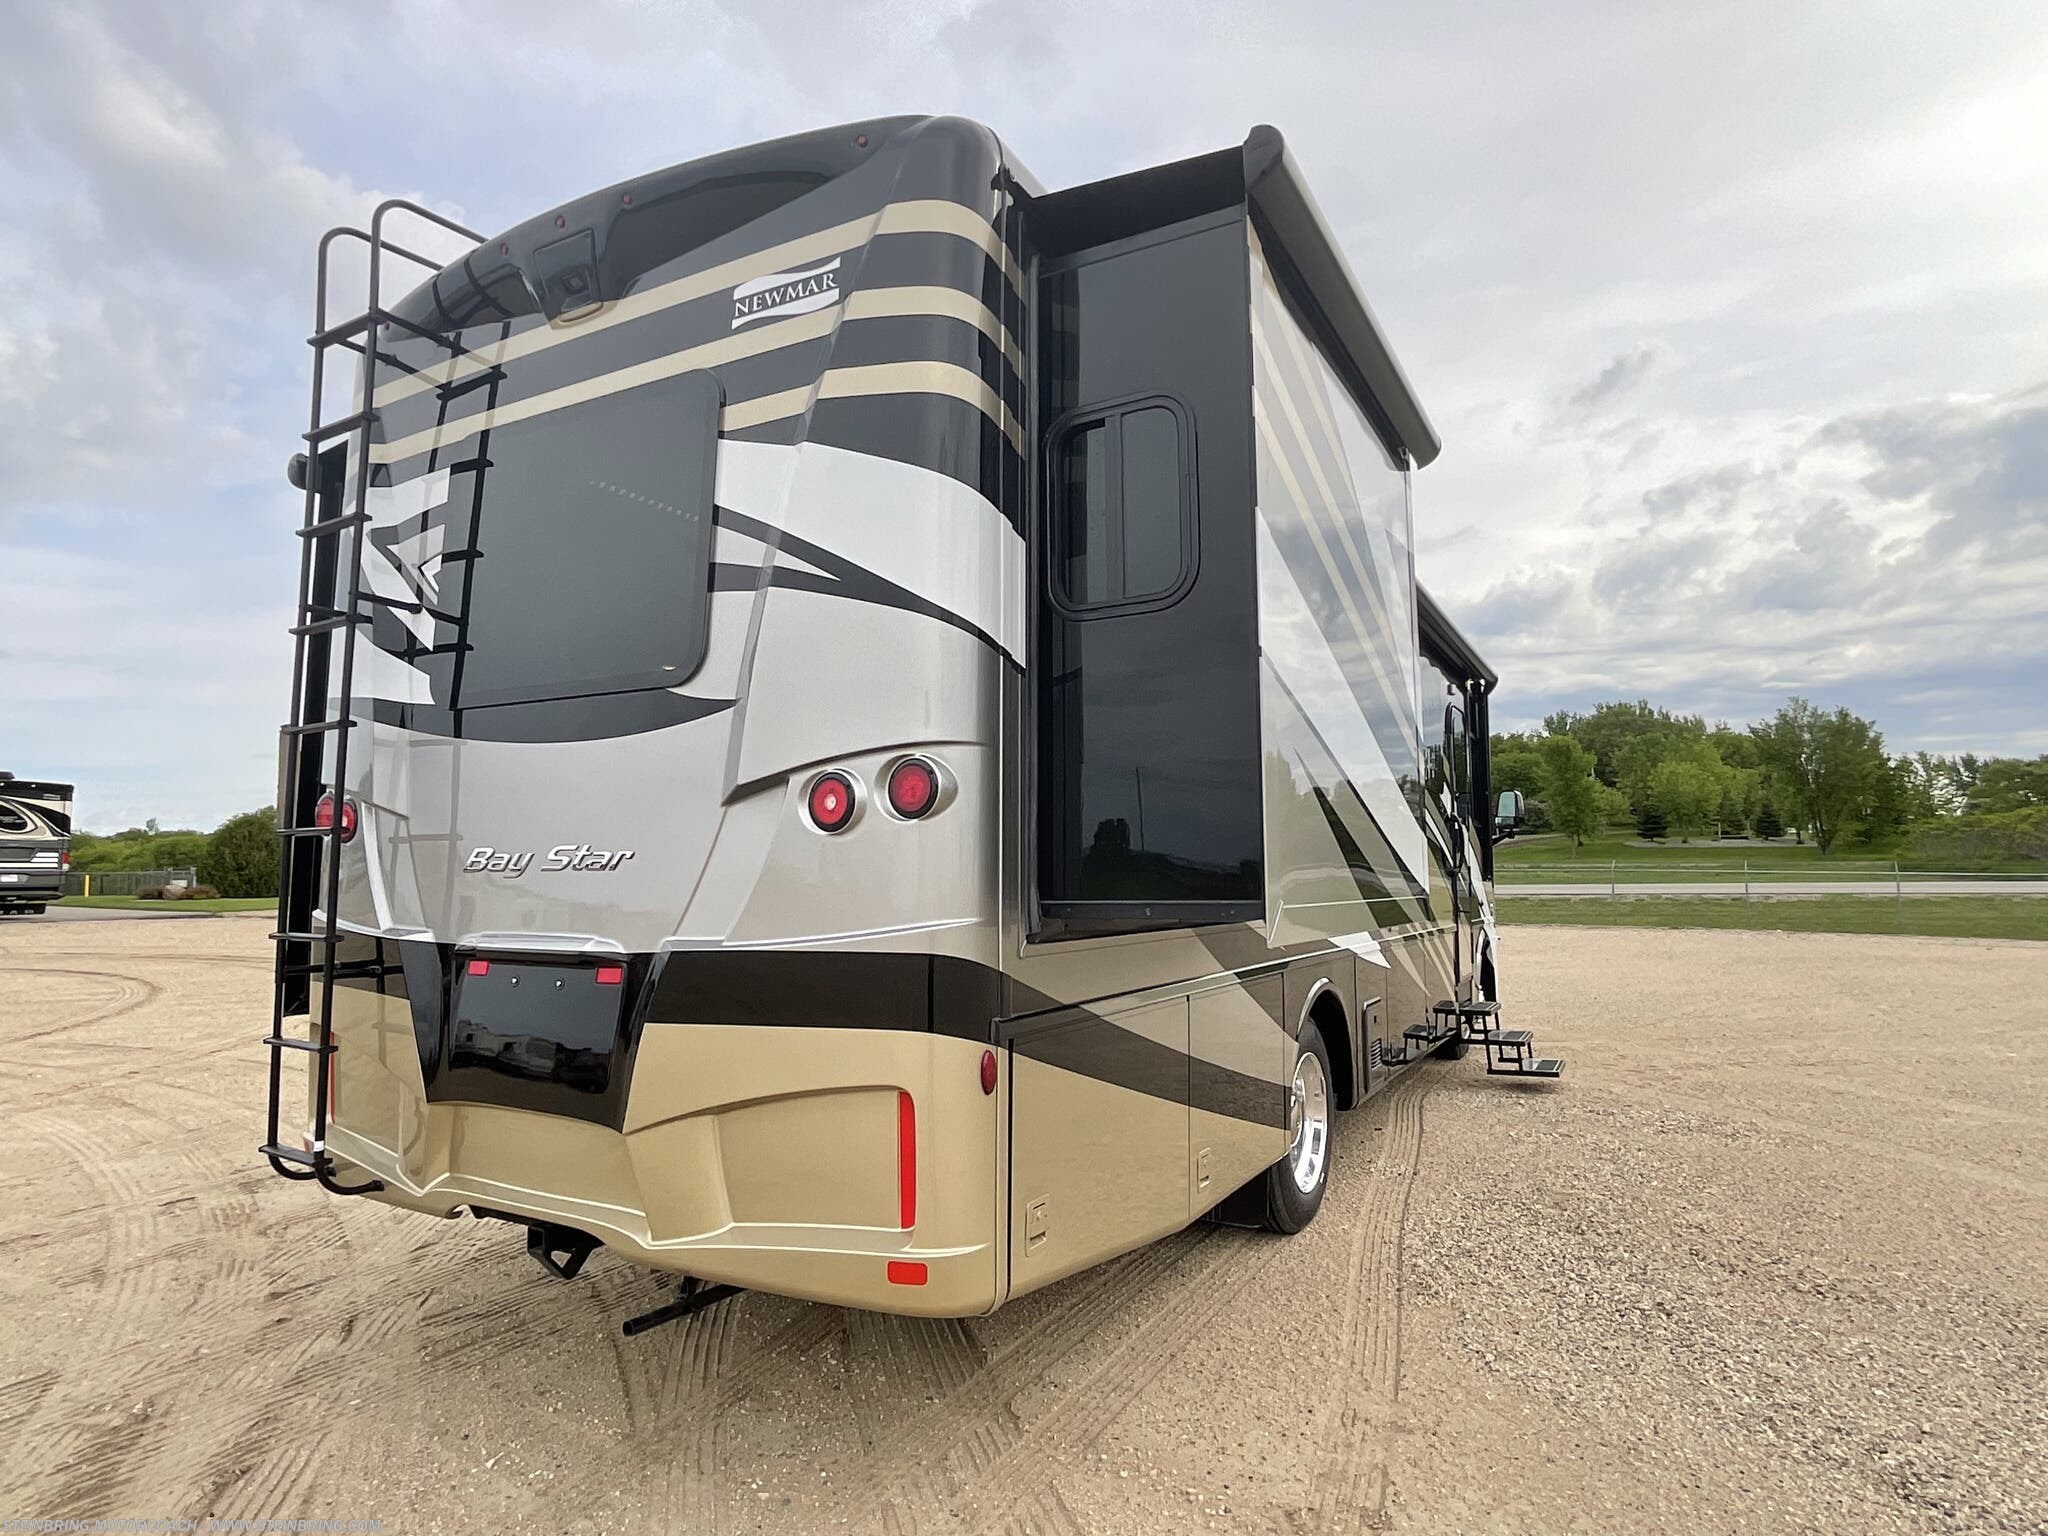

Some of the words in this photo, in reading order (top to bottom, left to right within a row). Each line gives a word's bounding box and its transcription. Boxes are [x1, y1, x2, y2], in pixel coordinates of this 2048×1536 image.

[735, 273, 837, 317] NEWMAR
[463, 847, 535, 879] Bay
[540, 843, 636, 872] Star
